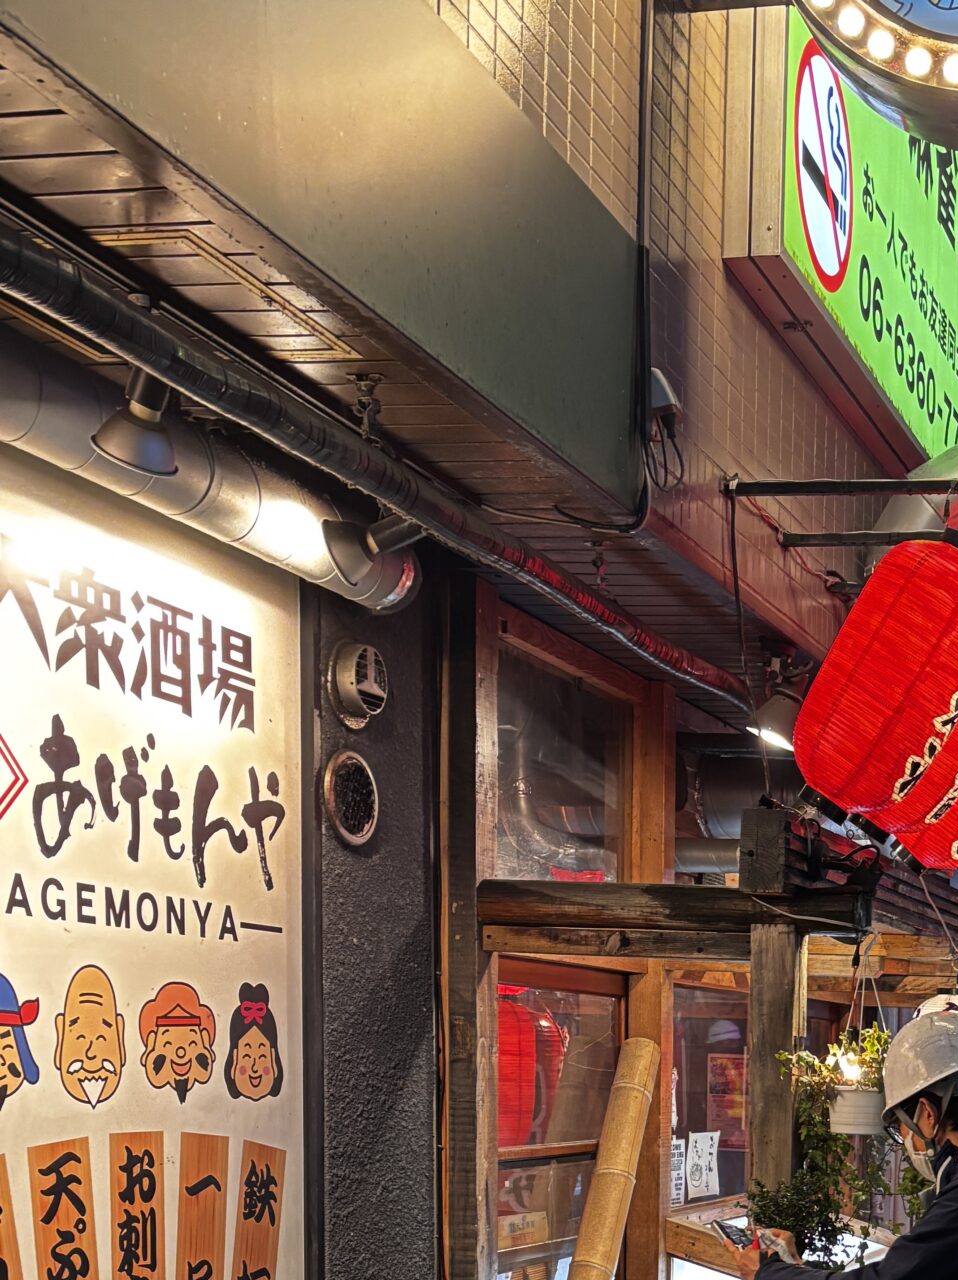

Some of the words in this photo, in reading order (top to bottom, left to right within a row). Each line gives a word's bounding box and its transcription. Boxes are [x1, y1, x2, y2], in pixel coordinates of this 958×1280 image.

[32, 712, 287, 890] あげもんや
[5, 872, 239, 942] AGEMONYA
